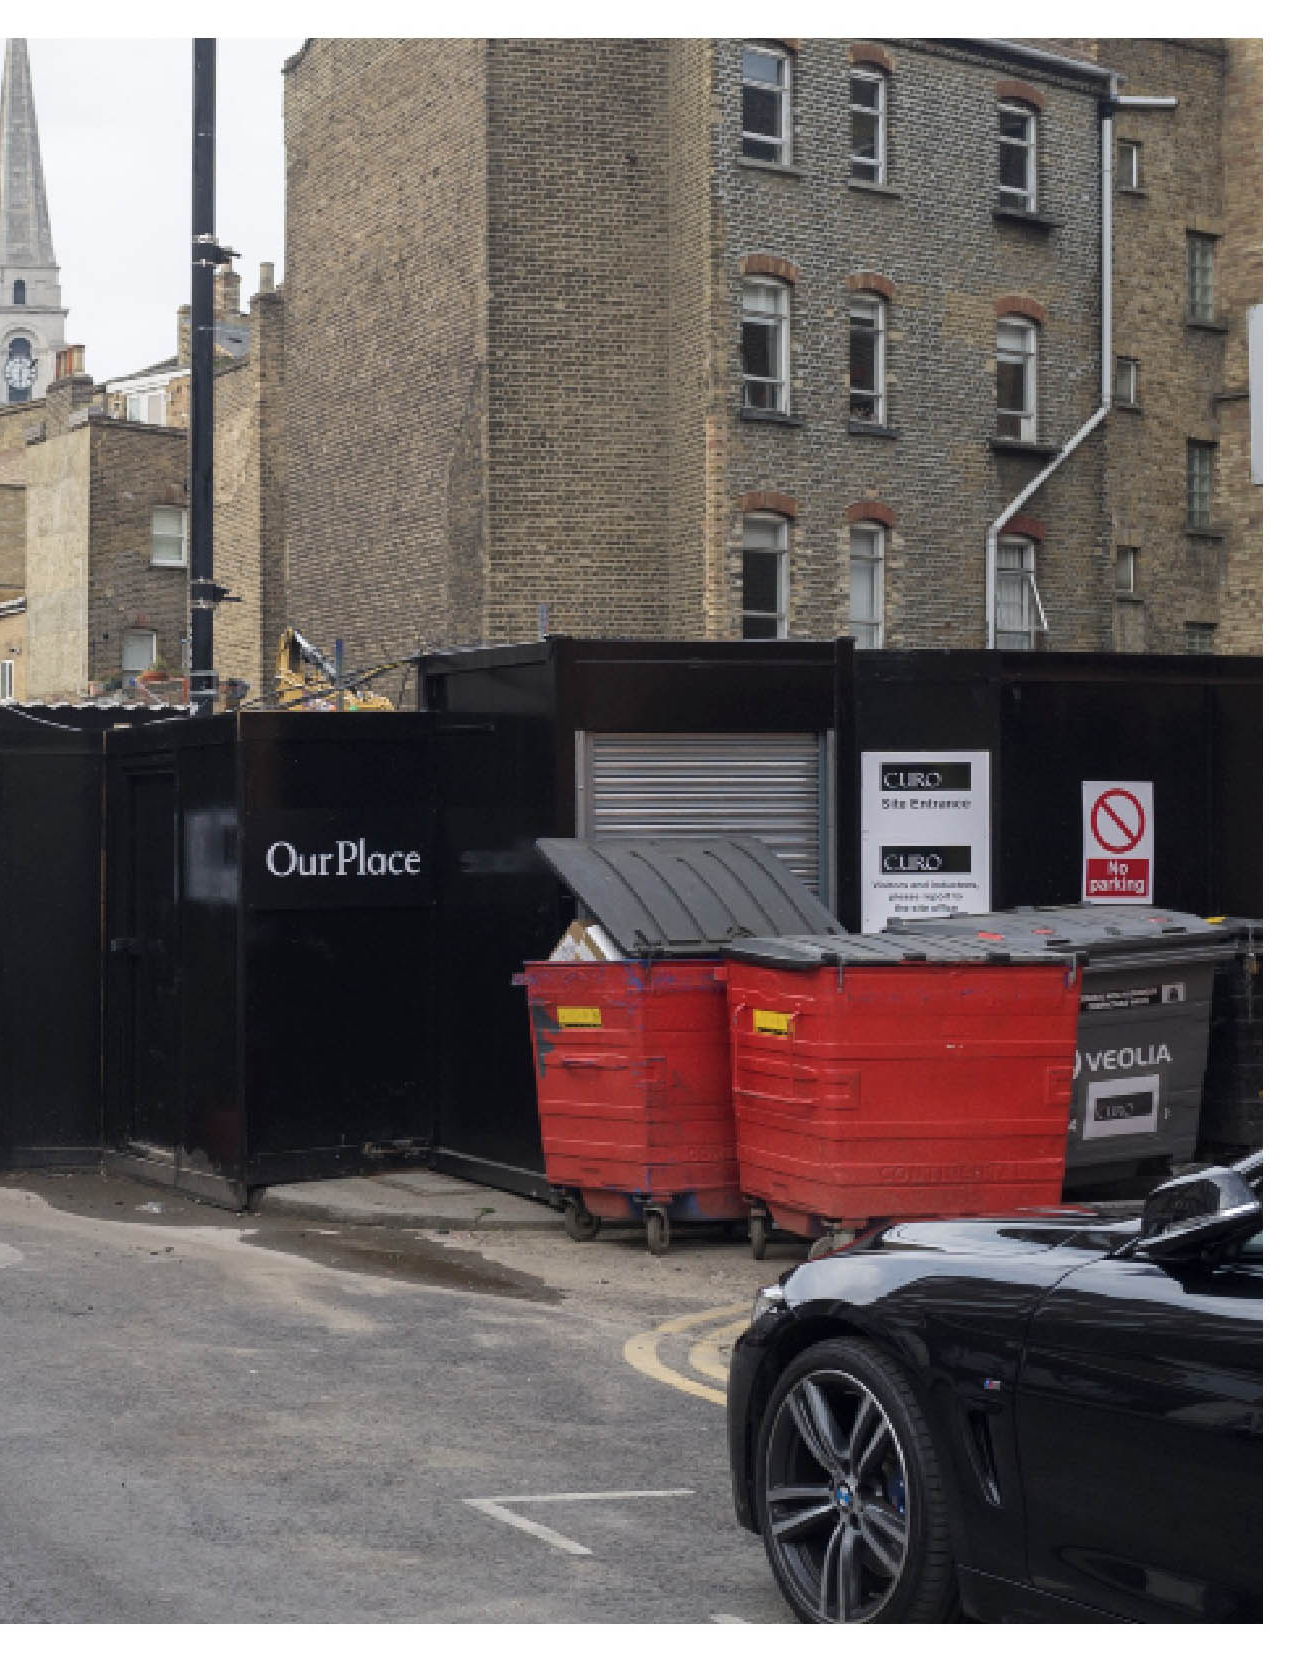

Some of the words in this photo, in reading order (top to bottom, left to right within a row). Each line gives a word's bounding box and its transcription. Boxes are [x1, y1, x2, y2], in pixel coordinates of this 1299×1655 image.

[883, 772, 943, 789] CURO
[882, 798, 906, 810] Site
[909, 798, 972, 810] Entrance
[883, 853, 943, 871] CURO
[1107, 860, 1129, 876] No
[1089, 877, 1146, 894] parking
[1085, 1044, 1174, 1072] VEOLIA
